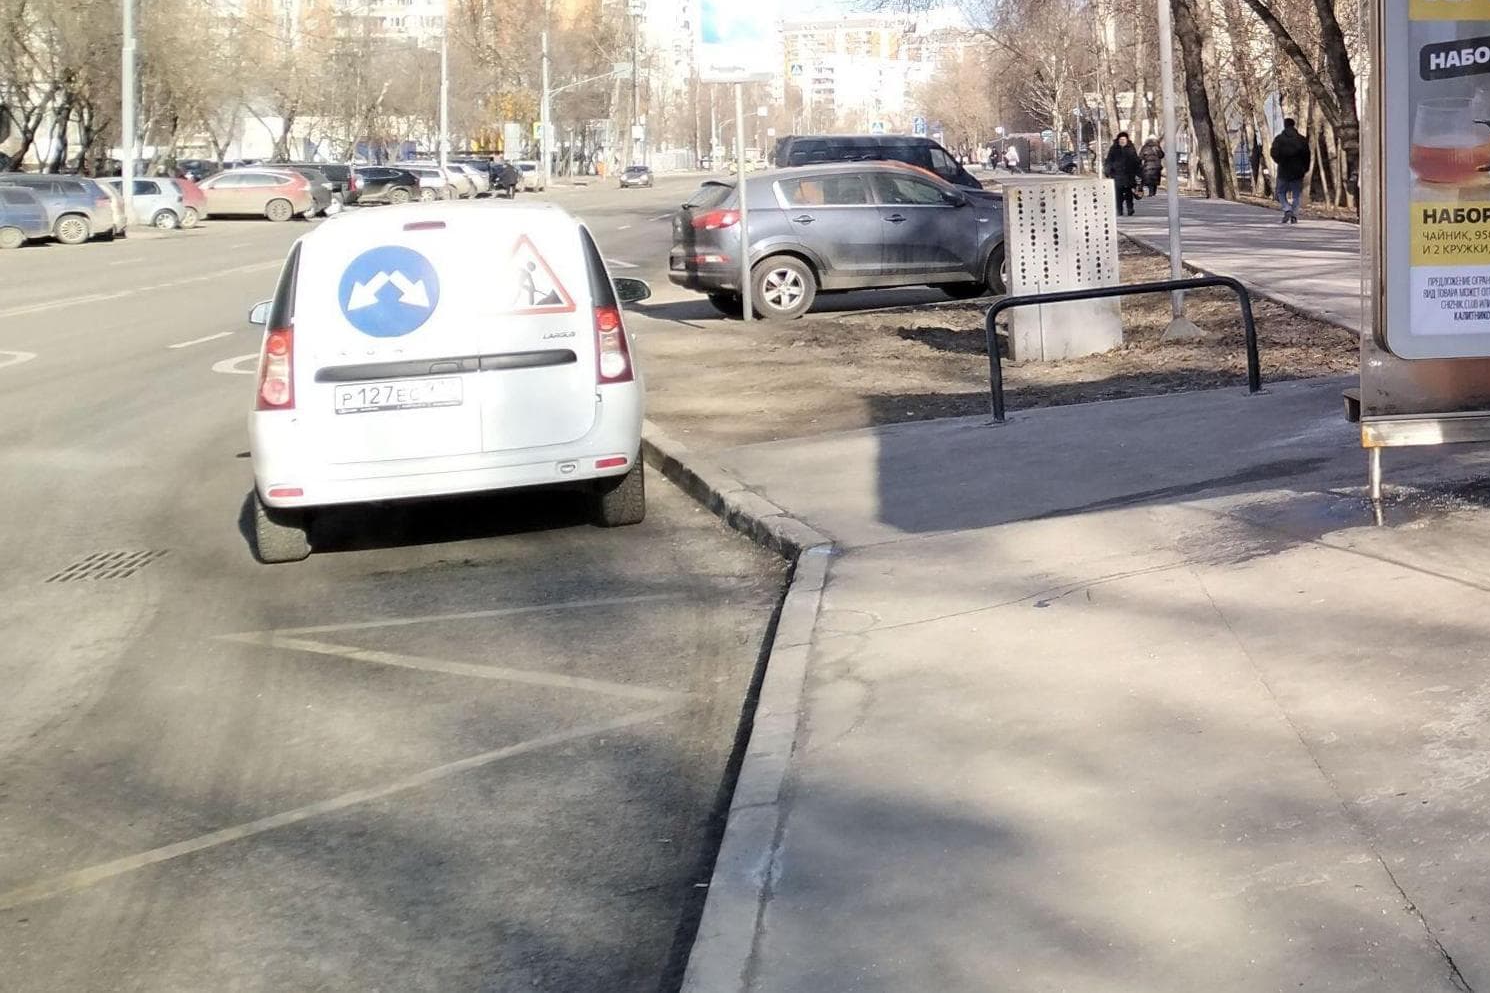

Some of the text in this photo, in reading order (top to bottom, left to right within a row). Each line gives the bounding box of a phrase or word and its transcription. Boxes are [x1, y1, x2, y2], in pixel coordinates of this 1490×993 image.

[1422, 229, 1472, 241] ЧАЙНИК,
[1422, 245, 1431, 254] И
[1433, 245, 1440, 254] 2
